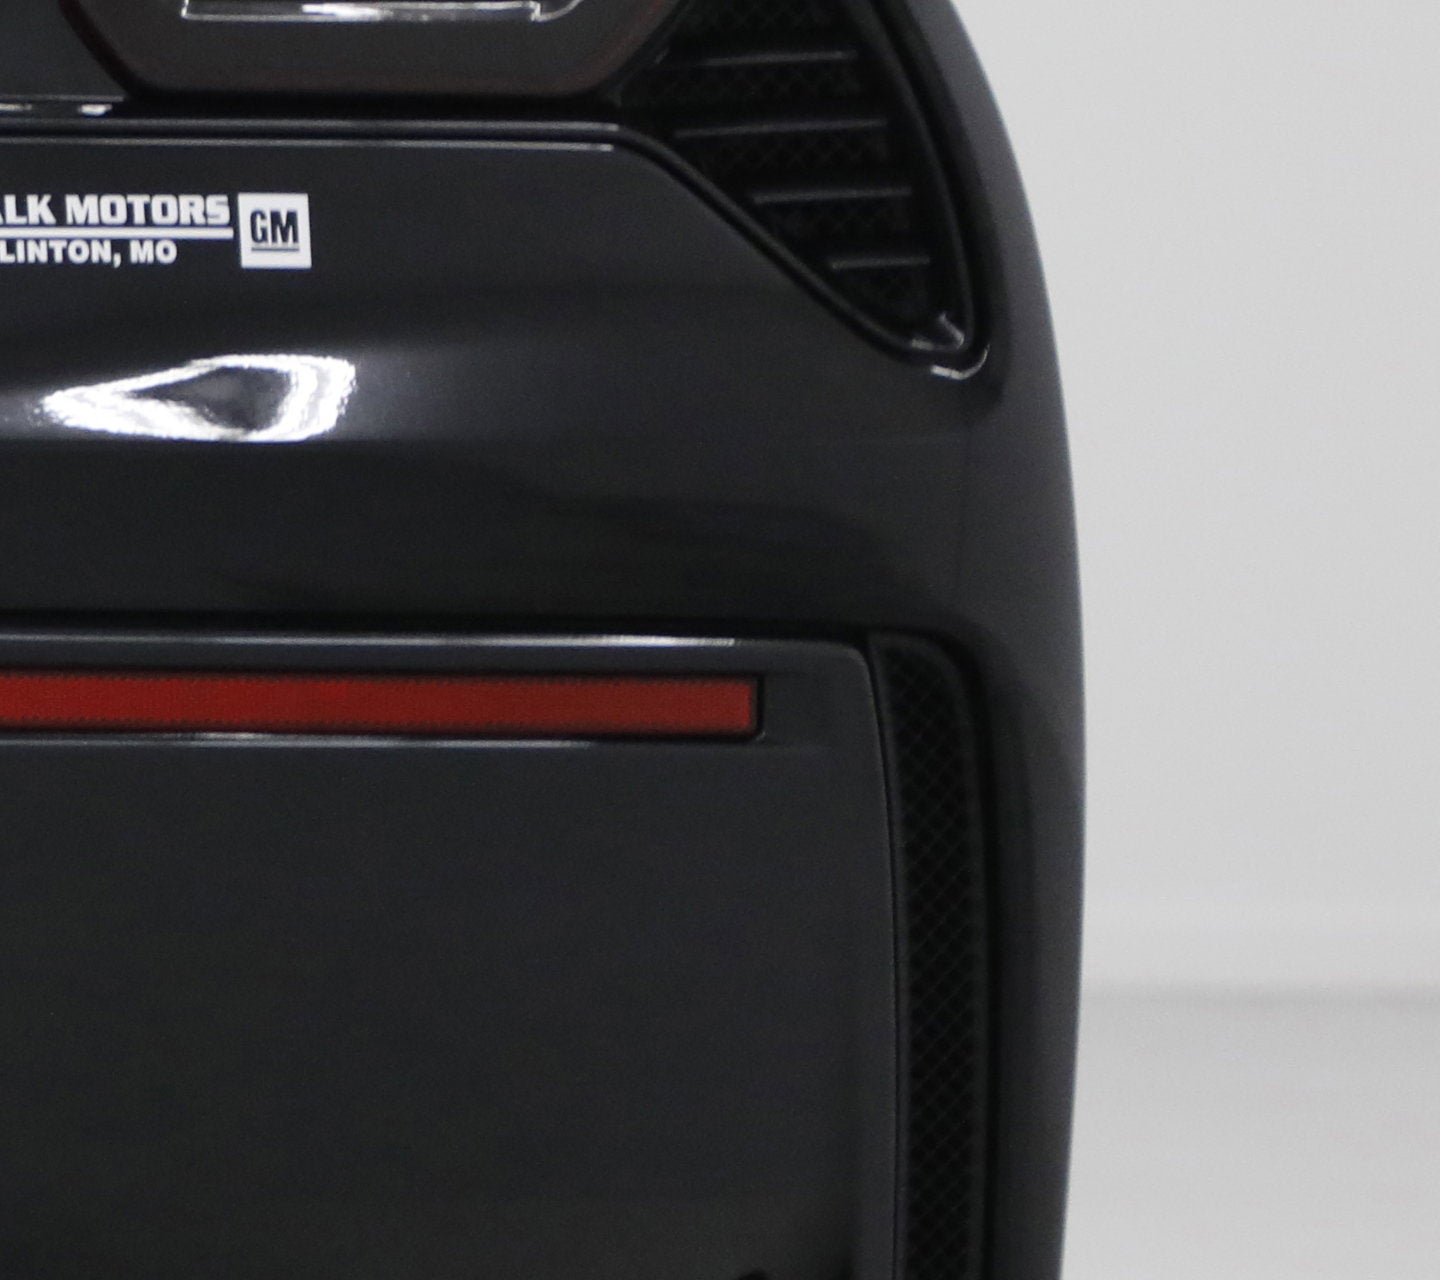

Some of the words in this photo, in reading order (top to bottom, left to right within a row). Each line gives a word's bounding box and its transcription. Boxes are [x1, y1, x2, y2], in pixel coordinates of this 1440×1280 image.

[64, 194, 231, 226] MOTORS
[250, 211, 299, 244] GM
[129, 239, 178, 264] MO
